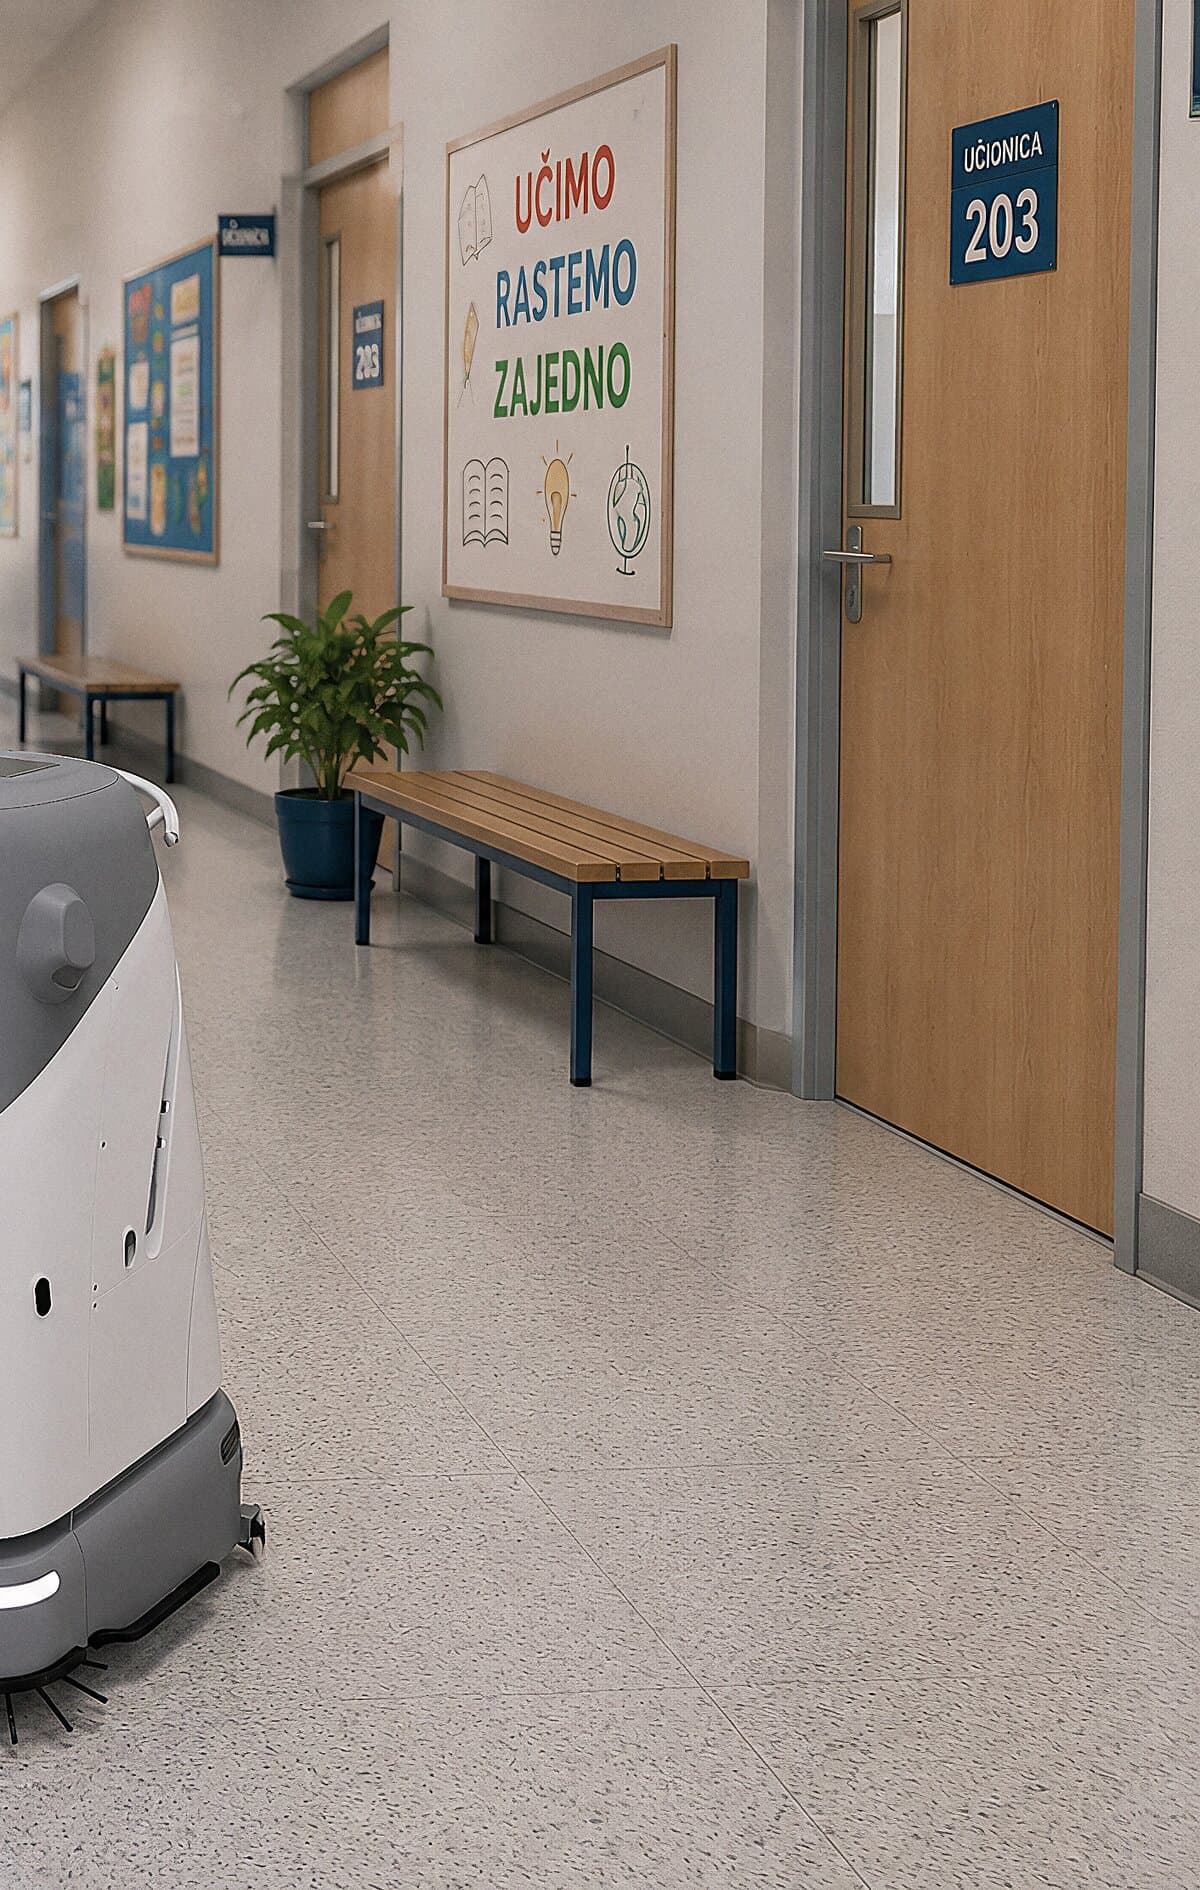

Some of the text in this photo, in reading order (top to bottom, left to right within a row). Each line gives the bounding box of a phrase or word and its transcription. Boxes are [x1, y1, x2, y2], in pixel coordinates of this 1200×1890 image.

[515, 144, 615, 234] UČIMO
[964, 131, 1043, 173] UČIONICA
[964, 188, 1039, 264] 203
[496, 239, 637, 329] RASTEMO
[493, 342, 631, 419] ZAJEDNO
